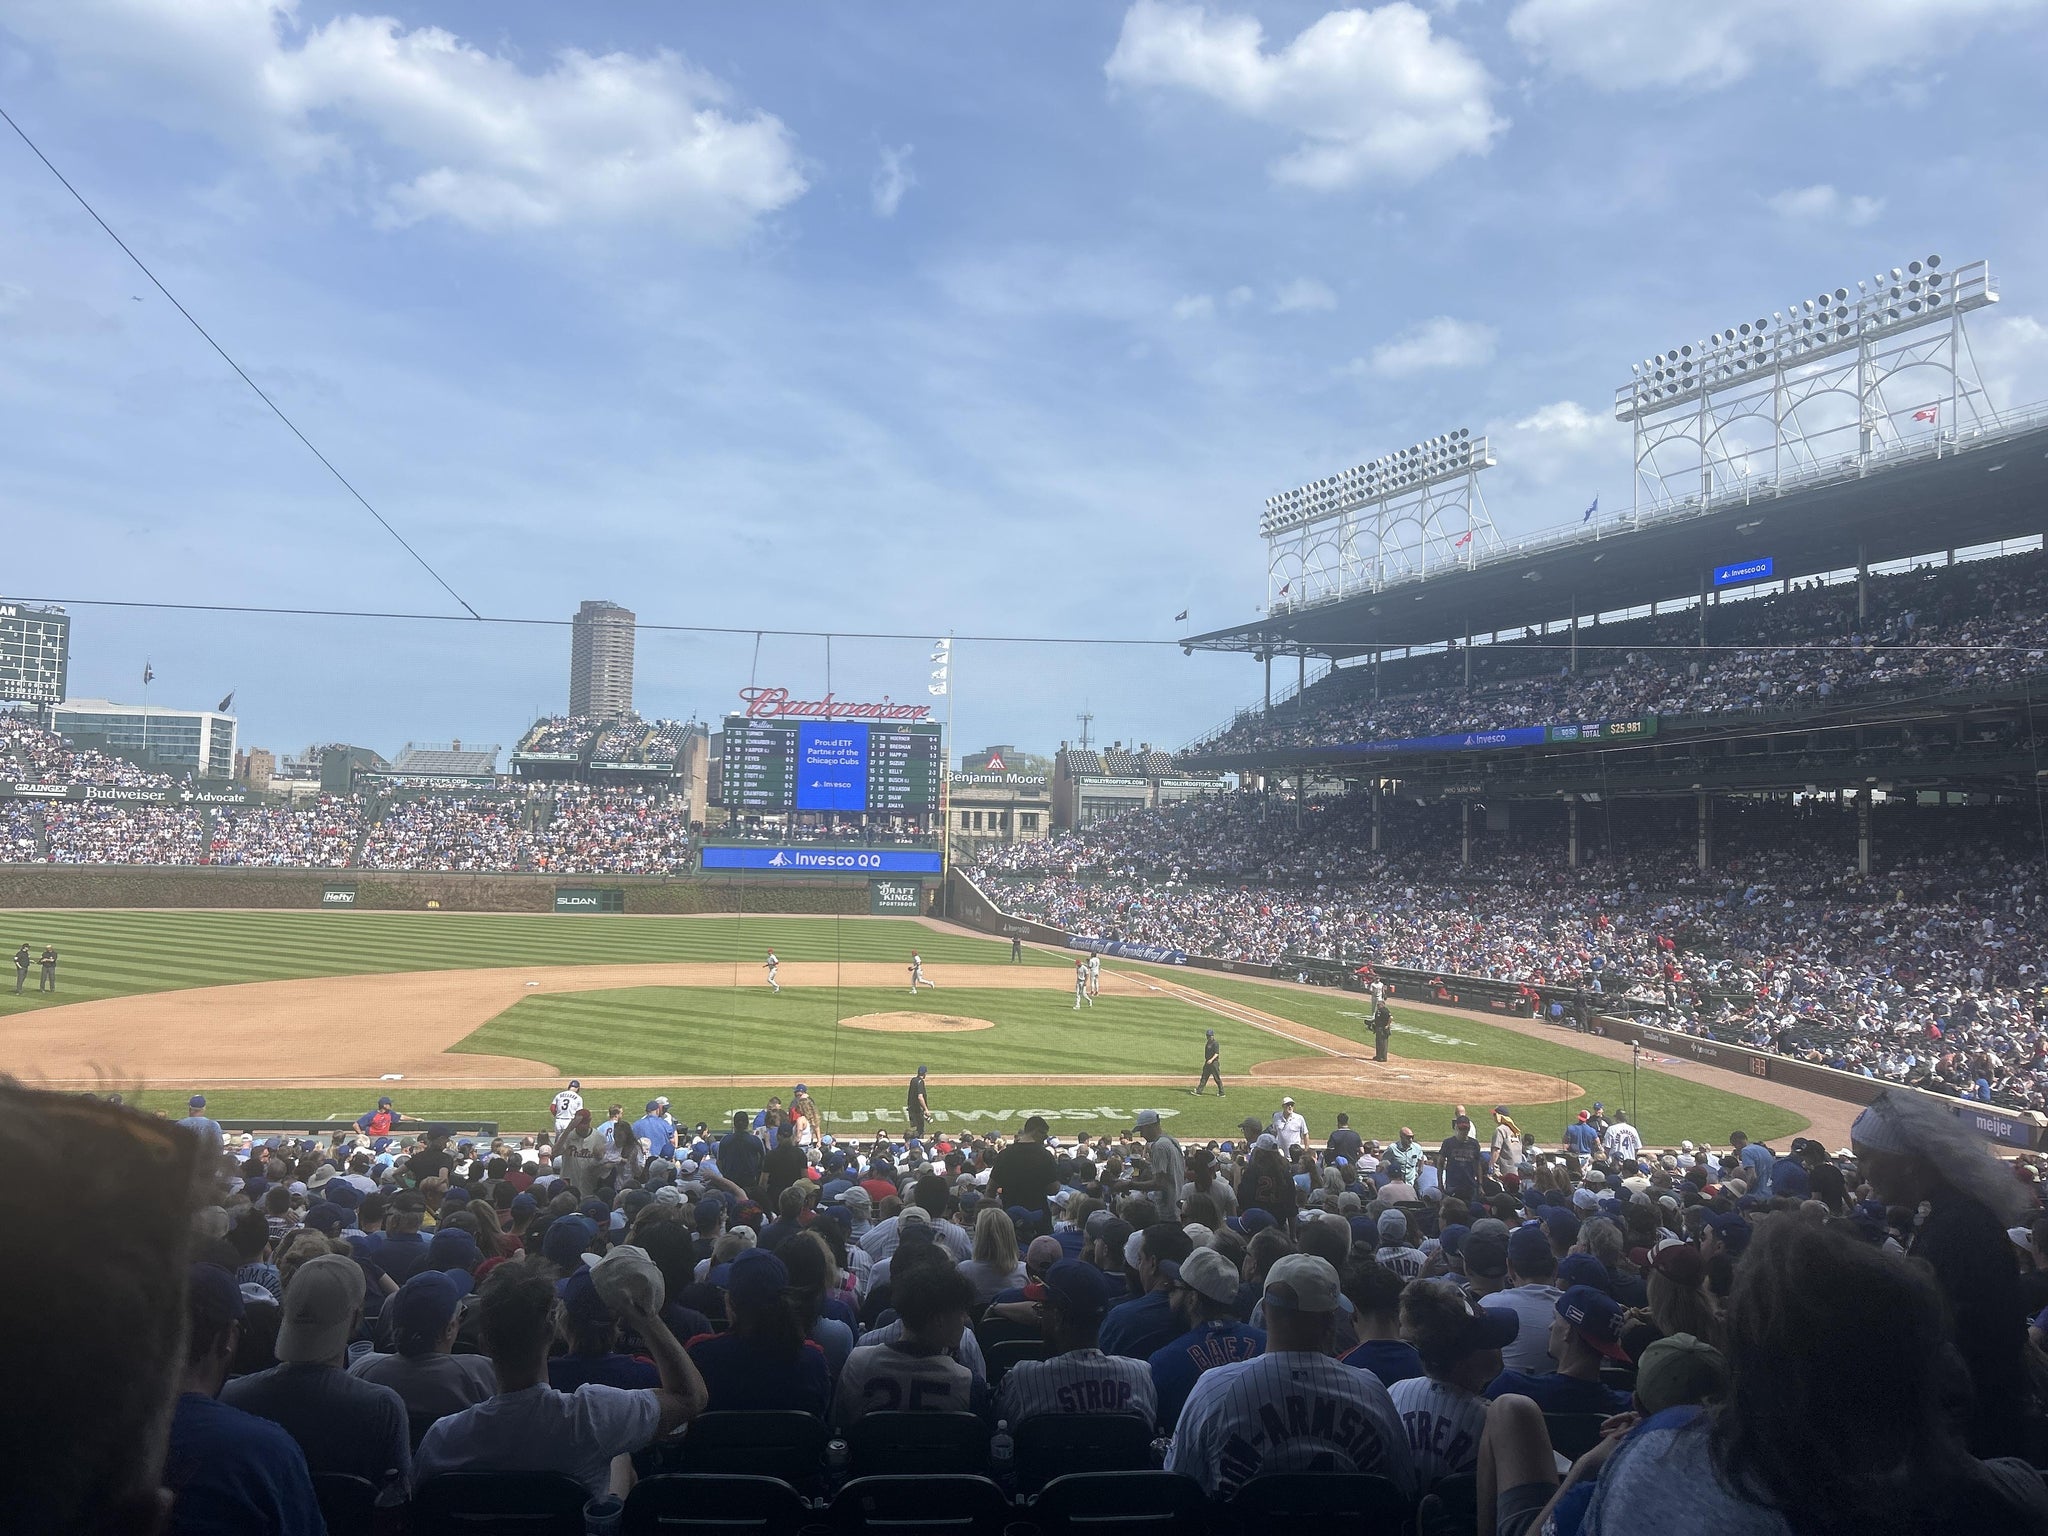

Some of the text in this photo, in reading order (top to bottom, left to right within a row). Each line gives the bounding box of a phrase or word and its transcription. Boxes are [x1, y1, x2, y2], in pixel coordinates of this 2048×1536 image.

[1732, 568, 1755, 576] Invesco
[739, 687, 931, 720] Budweiser
[1610, 722, 1641, 734] $25,981
[1477, 734, 1506, 744] Invesco
[807, 757, 838, 765] Chicago
[947, 772, 1046, 784] Benjamin Moore
[14, 784, 68, 792] GRAINGER
[86, 786, 166, 800] Budweiser
[196, 792, 244, 802] Advocate
[796, 852, 881, 867] Invesco QQ
[880, 887, 916, 896] DRAFT
[326, 894, 352, 902] Hefty
[1118, 944, 1160, 962] Reynolds Wrap
[562, 1098, 570, 1110] 3
[1976, 1116, 2012, 1136] meijer
[1622, 1136, 1630, 1150] 4
[1186, 1332, 1256, 1372] BÁEZ
[1057, 1379, 1132, 1413] STROP
